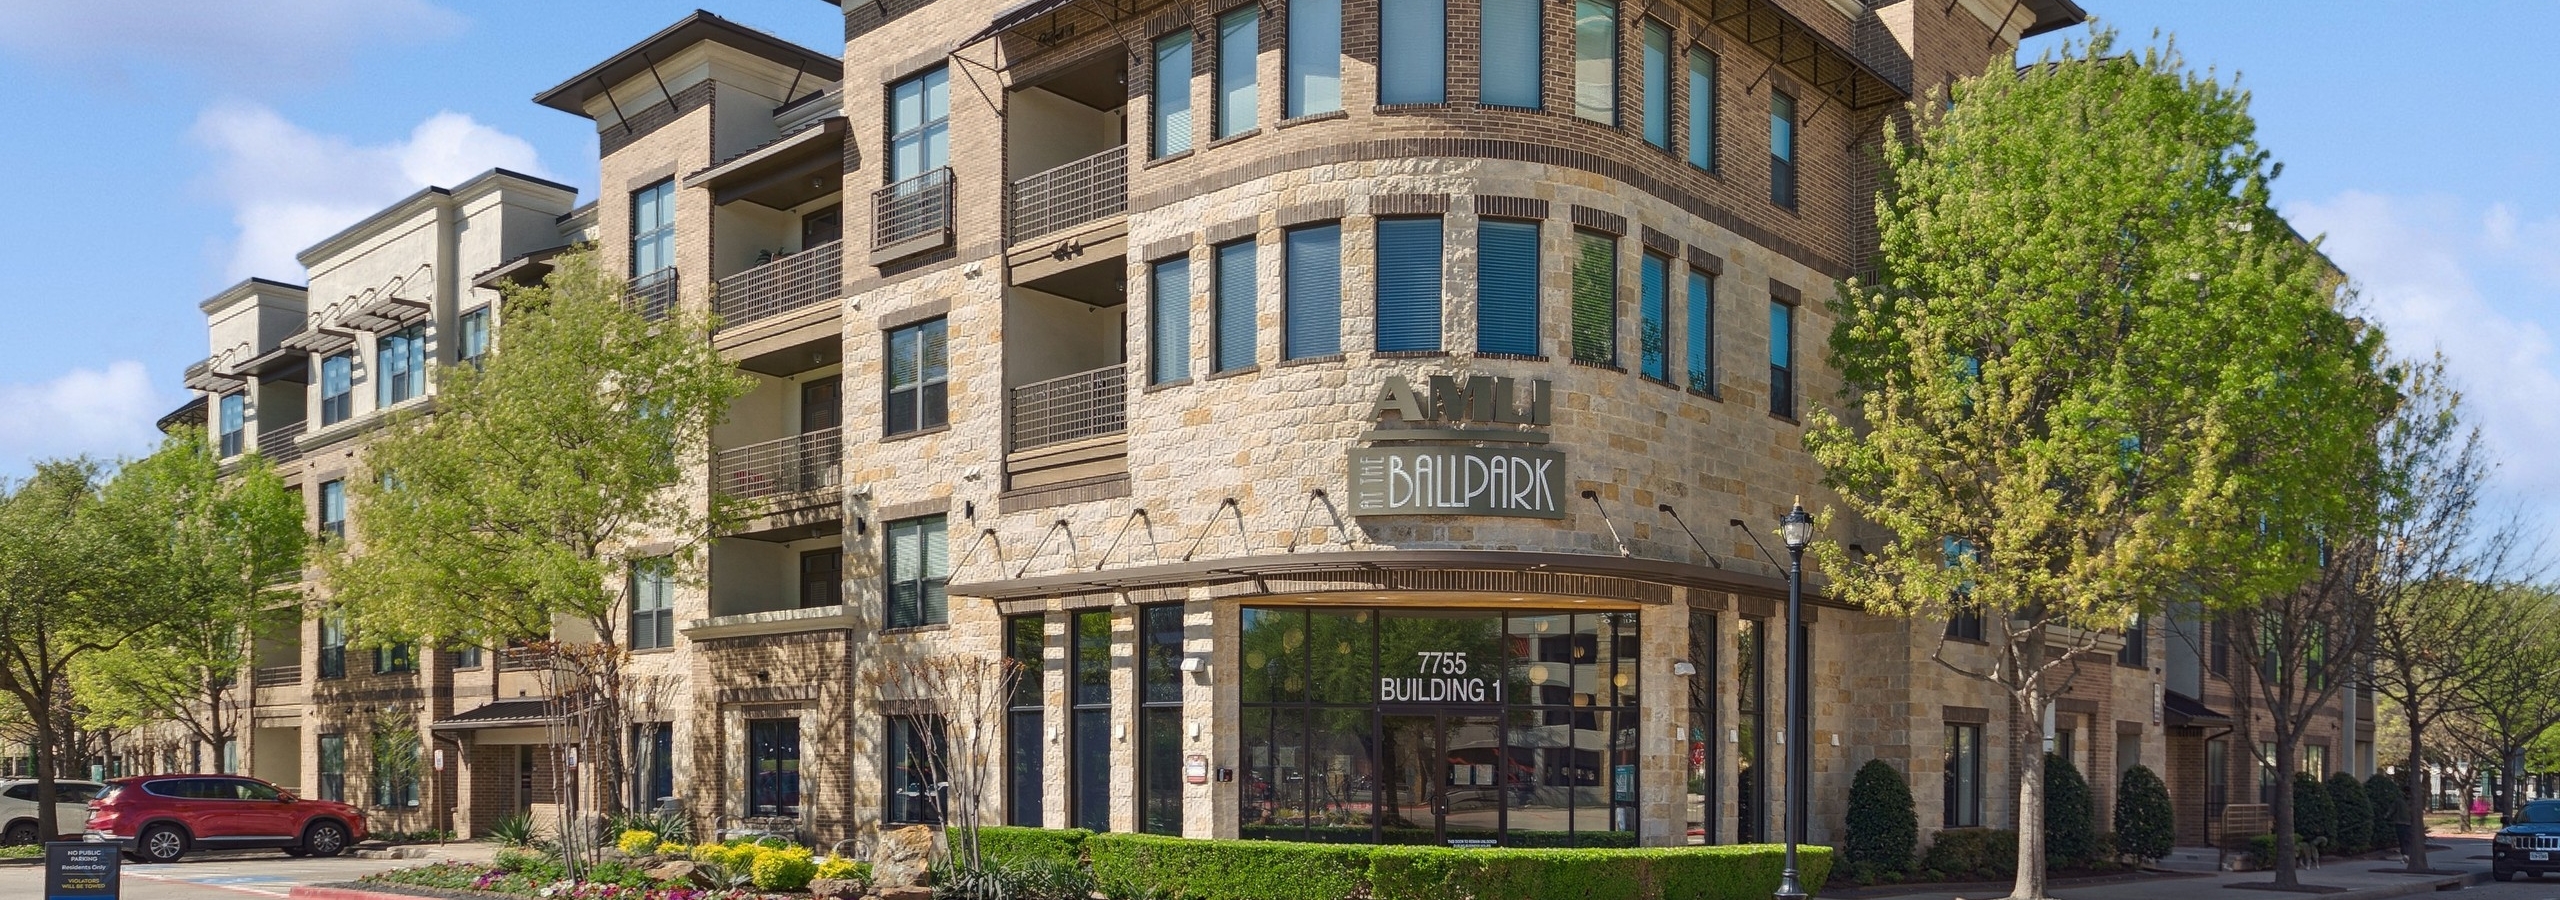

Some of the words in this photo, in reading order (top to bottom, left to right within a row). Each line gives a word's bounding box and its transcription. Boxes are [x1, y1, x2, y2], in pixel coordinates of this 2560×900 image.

[1366, 375, 1551, 426] AMLI
[1360, 456, 1385, 486] THE
[1389, 454, 1555, 512] BALLPARK
[1360, 492, 1384, 509] AT
[1418, 651, 1467, 675] 7755
[1381, 677, 1485, 702] BUILDING
[1492, 679, 1501, 702] 1
